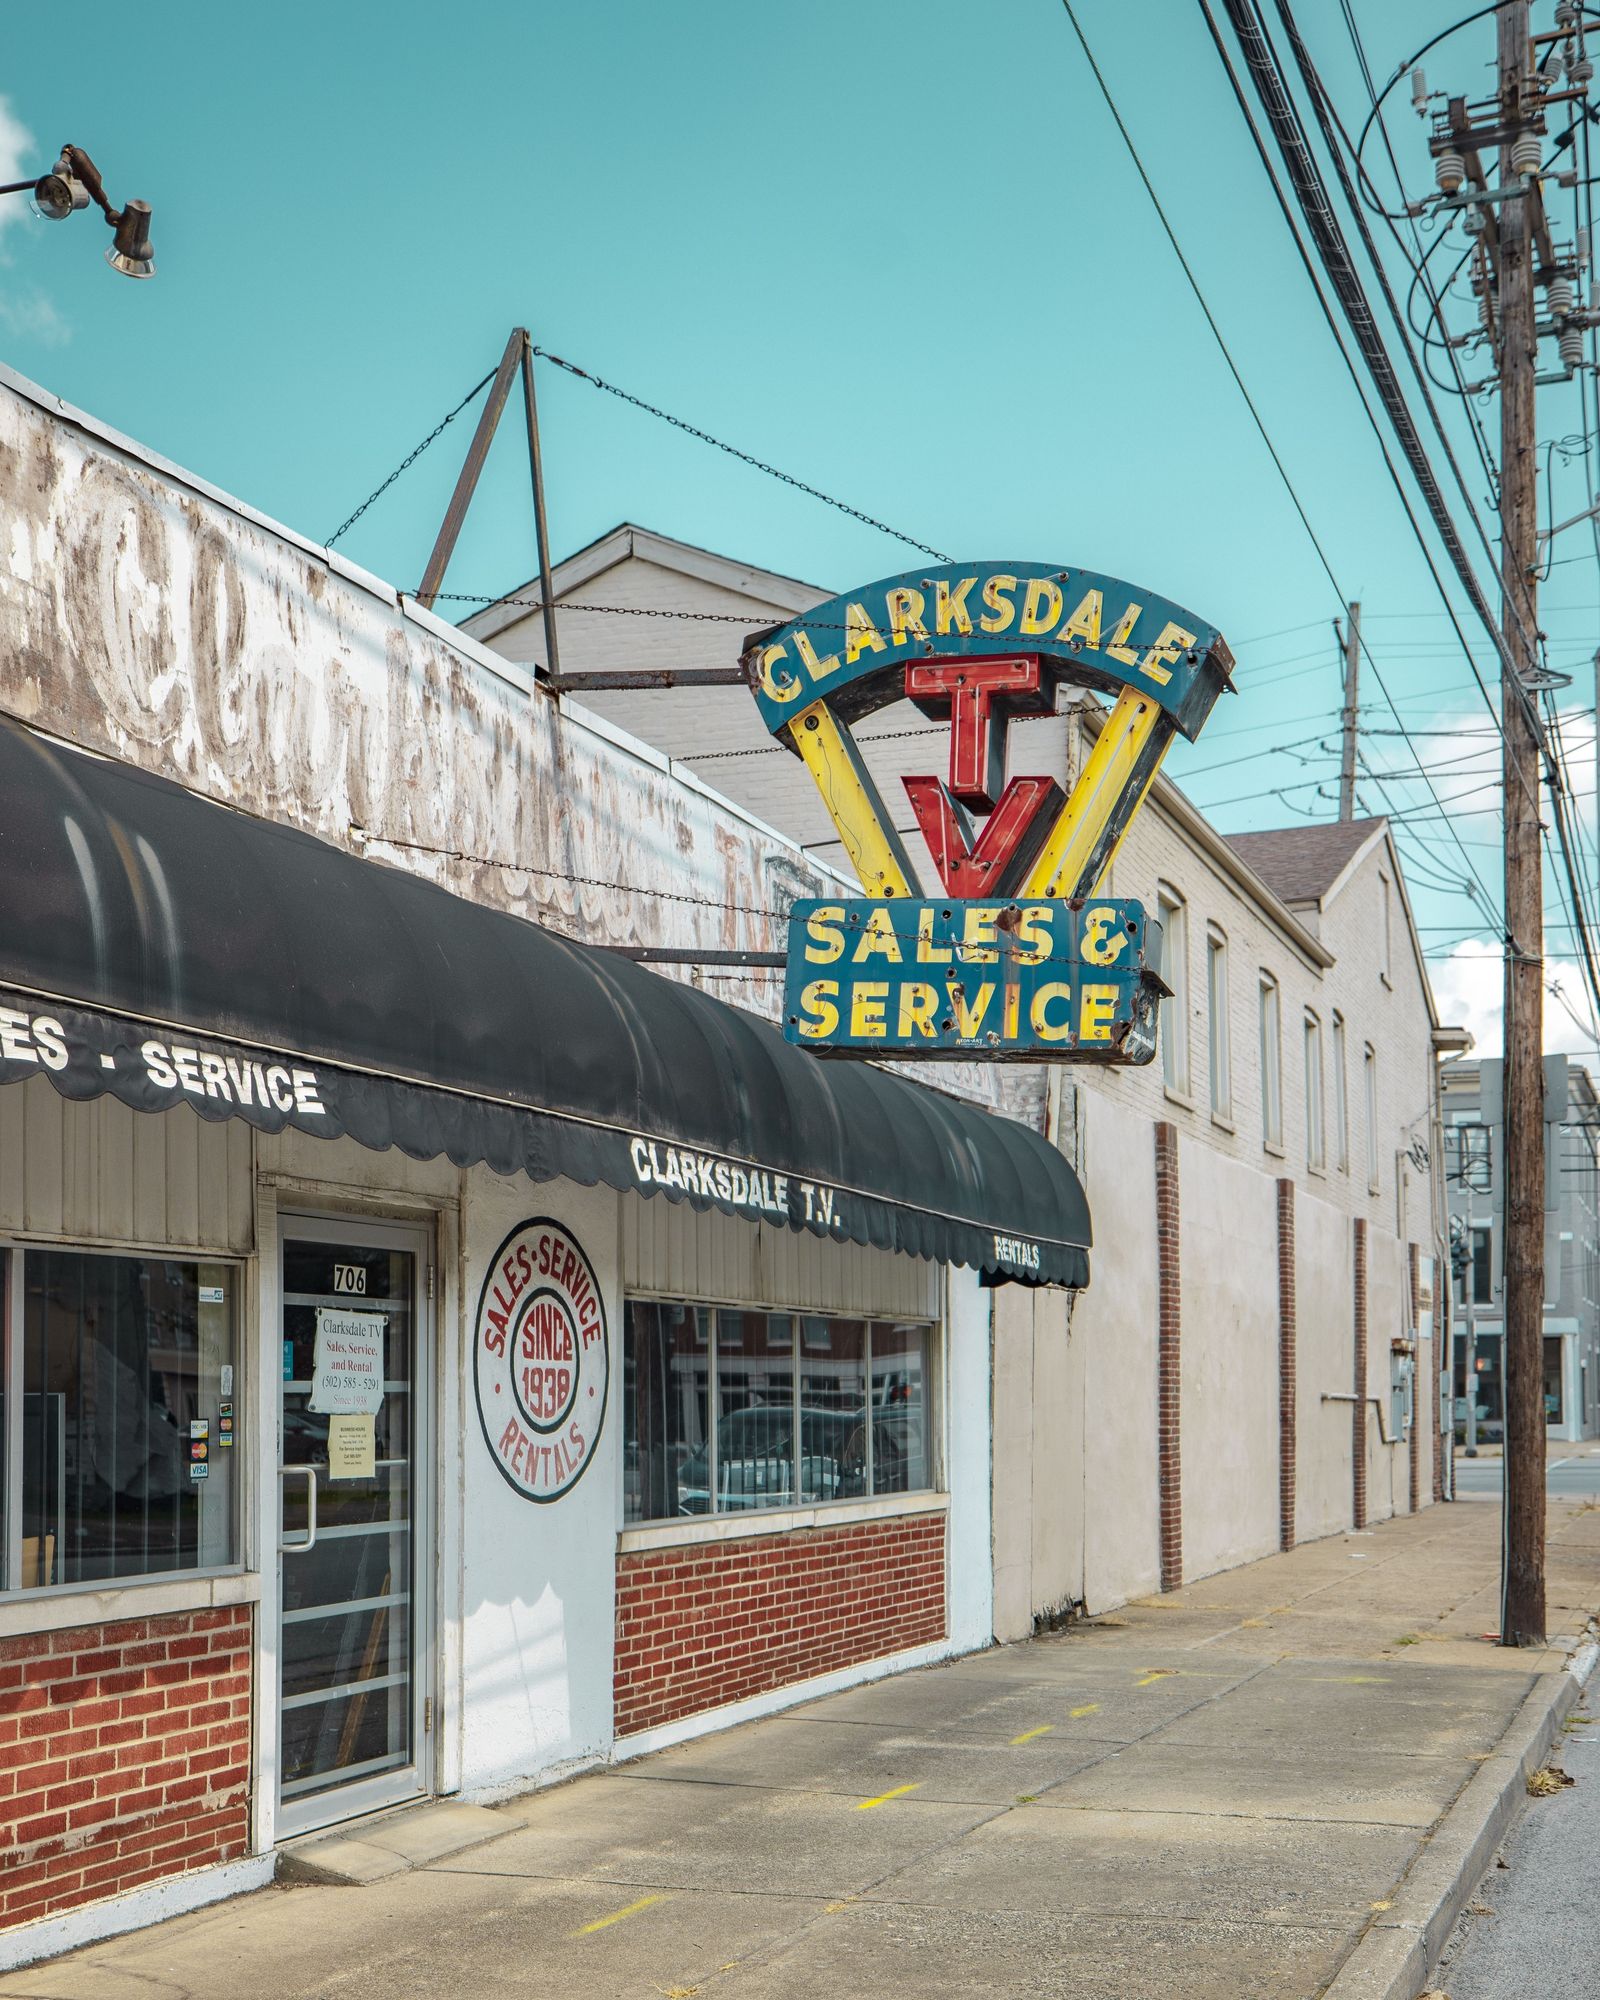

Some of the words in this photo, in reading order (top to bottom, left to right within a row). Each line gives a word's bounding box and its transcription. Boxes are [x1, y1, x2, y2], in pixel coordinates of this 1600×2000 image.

[759, 575, 1199, 704] CLARKSDALE
[804, 906, 1055, 966] SALES
[1080, 906, 1129, 965] &
[798, 980, 1122, 1041] SERVICE
[0, 1006, 69, 1071] ES
[140, 1040, 326, 1115] SERVICE
[630, 1137, 789, 1213] CLARKSDALE
[801, 1184, 841, 1227] T.V.
[994, 1235, 1040, 1269] RENTALS
[335, 1267, 365, 1292] 706
[485, 1244, 532, 1359] SALES
[538, 1234, 601, 1350] SERVICE
[323, 1319, 367, 1337] Clarksdale
[368, 1324, 382, 1338] TV
[322, 1376, 341, 1390] (502)
[343, 1376, 357, 1389] 585
[331, 1360, 346, 1371] and
[347, 1360, 372, 1373] Rental
[522, 1366, 570, 1419] 1938
[333, 1395, 352, 1405] Since
[192, 1465, 207, 1475] VISA
[499, 1416, 586, 1488] RENTALS
